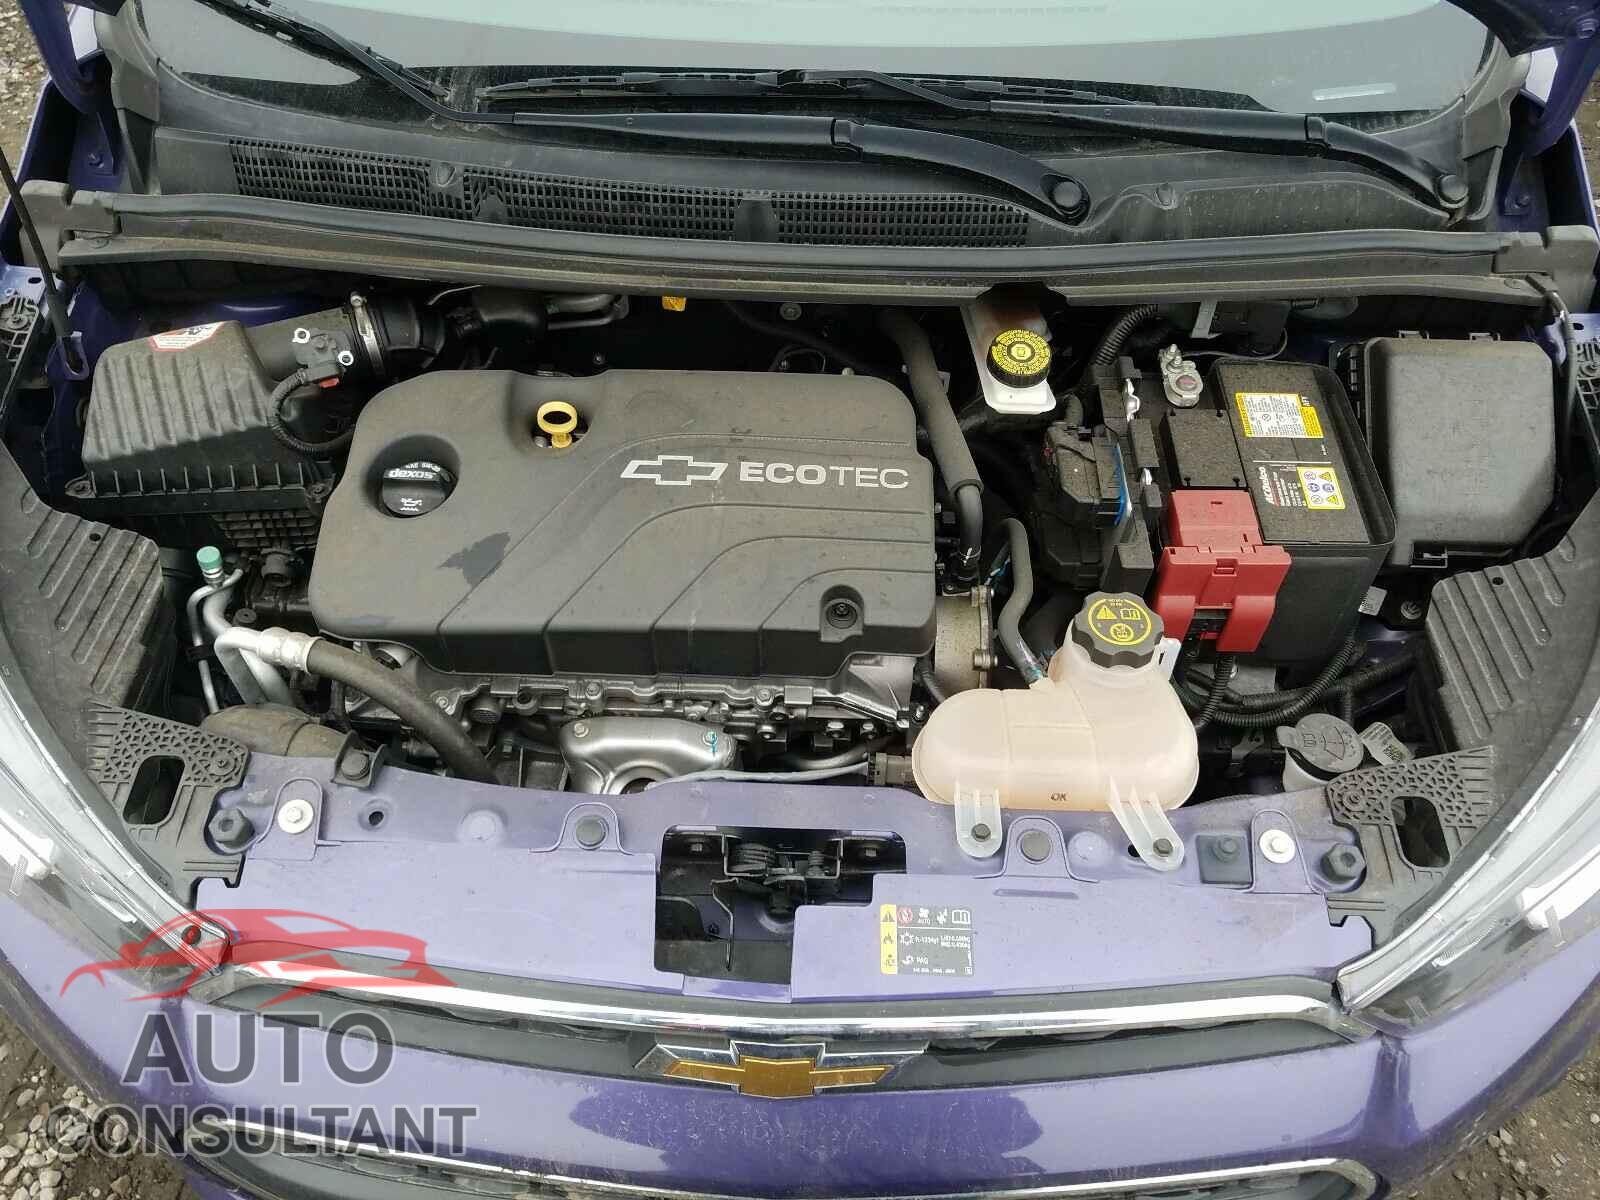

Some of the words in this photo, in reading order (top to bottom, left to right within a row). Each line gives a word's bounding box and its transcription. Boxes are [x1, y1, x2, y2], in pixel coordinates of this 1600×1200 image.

[388, 468, 434, 479] dexos
[739, 461, 909, 489] ECOTEC
[1050, 792, 1066, 801] OK
